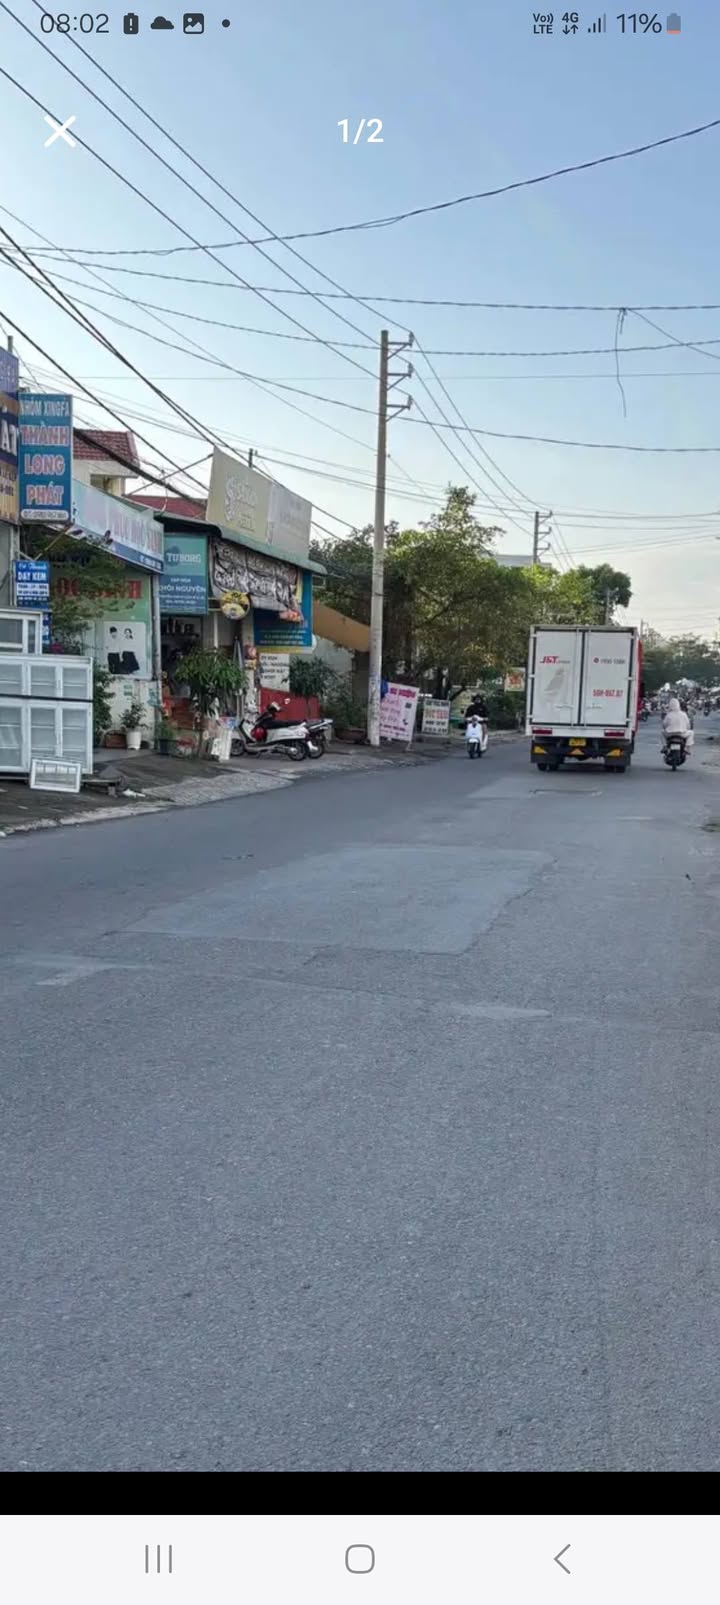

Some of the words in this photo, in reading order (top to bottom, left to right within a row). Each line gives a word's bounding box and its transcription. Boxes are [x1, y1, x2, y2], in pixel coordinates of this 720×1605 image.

[20, 421, 70, 446] THÀNH
[24, 453, 66, 476] LONG
[26, 481, 64, 505] PHÁT
[166, 552, 201, 563] TUBORG
